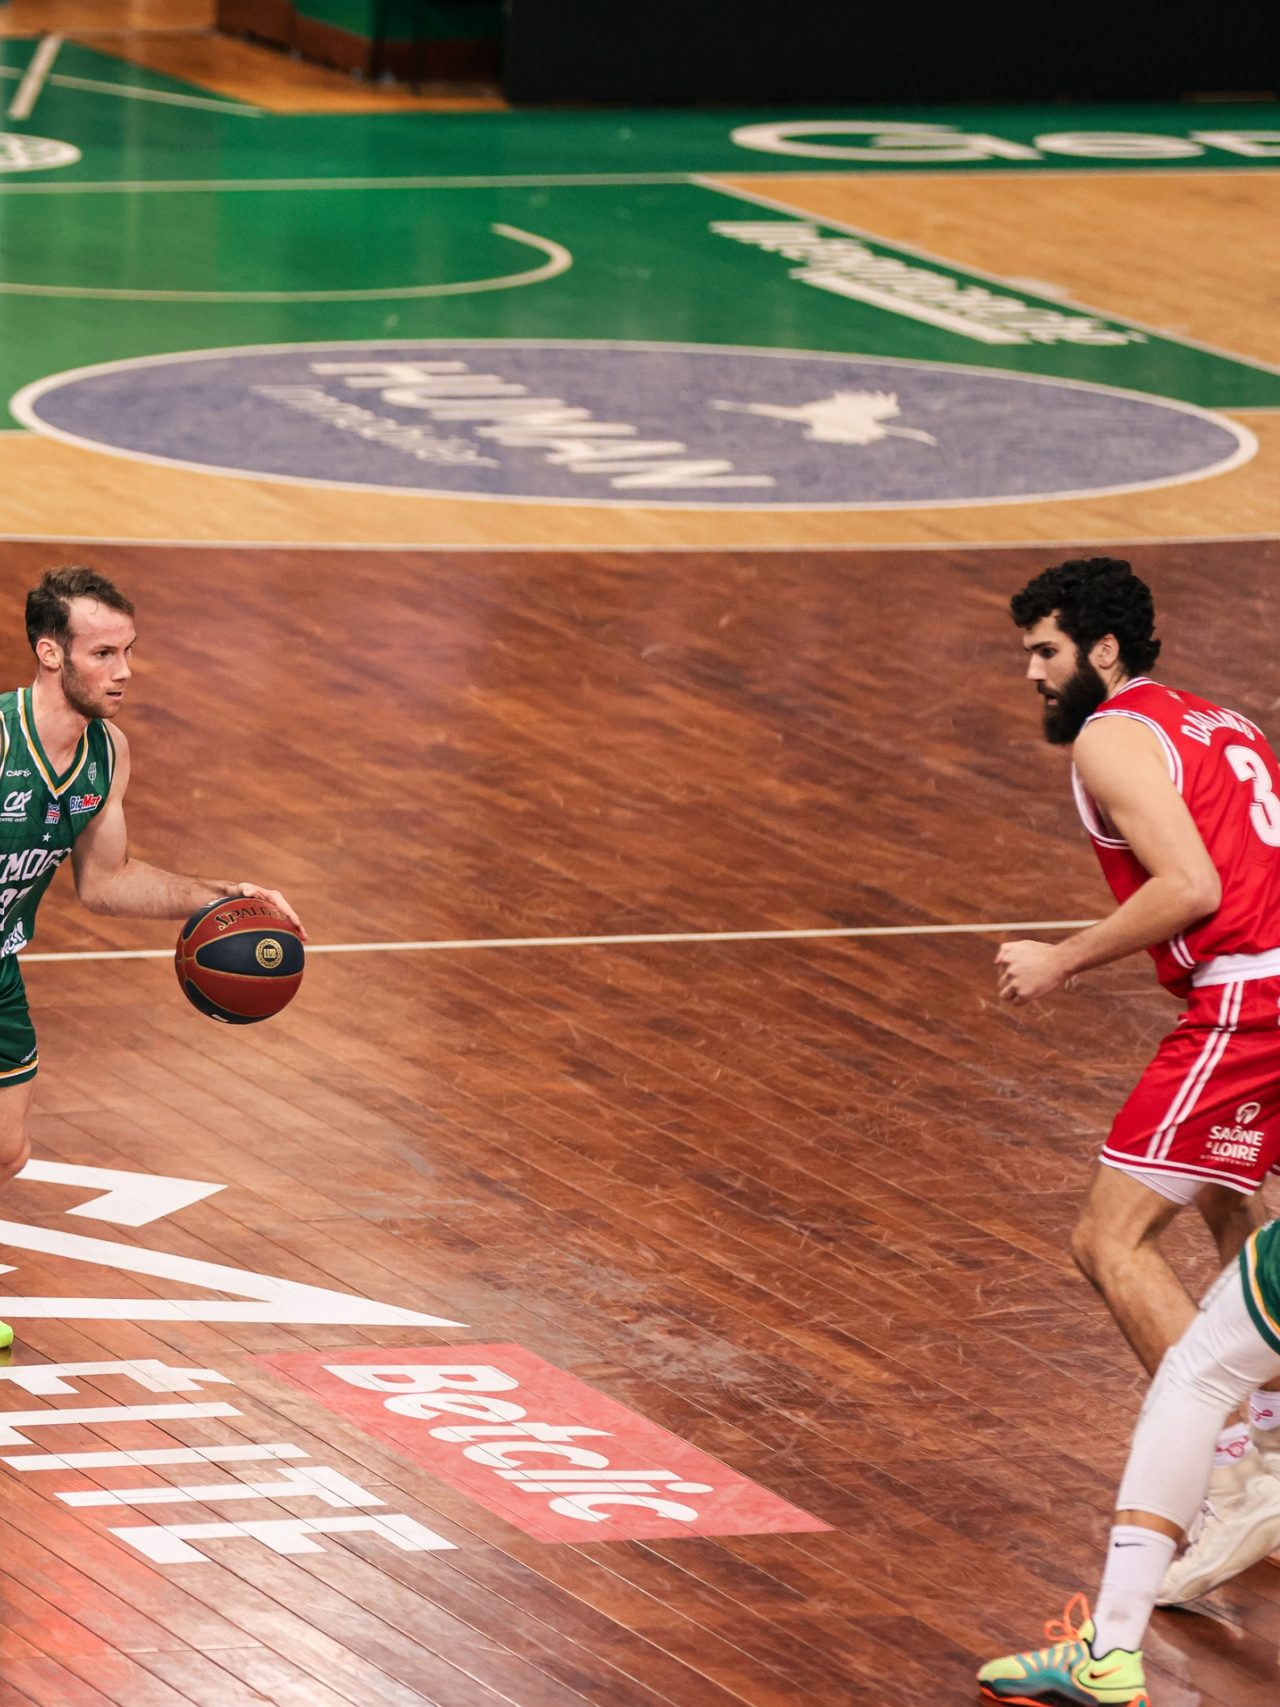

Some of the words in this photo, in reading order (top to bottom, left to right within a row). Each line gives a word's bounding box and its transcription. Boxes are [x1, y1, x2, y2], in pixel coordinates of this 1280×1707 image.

[310, 361, 776, 489] HUMAN
[1208, 1125, 1265, 1147] SAÔNE
[1211, 1142, 1261, 1162] LOIRE
[321, 1364, 715, 1523] Betclic
